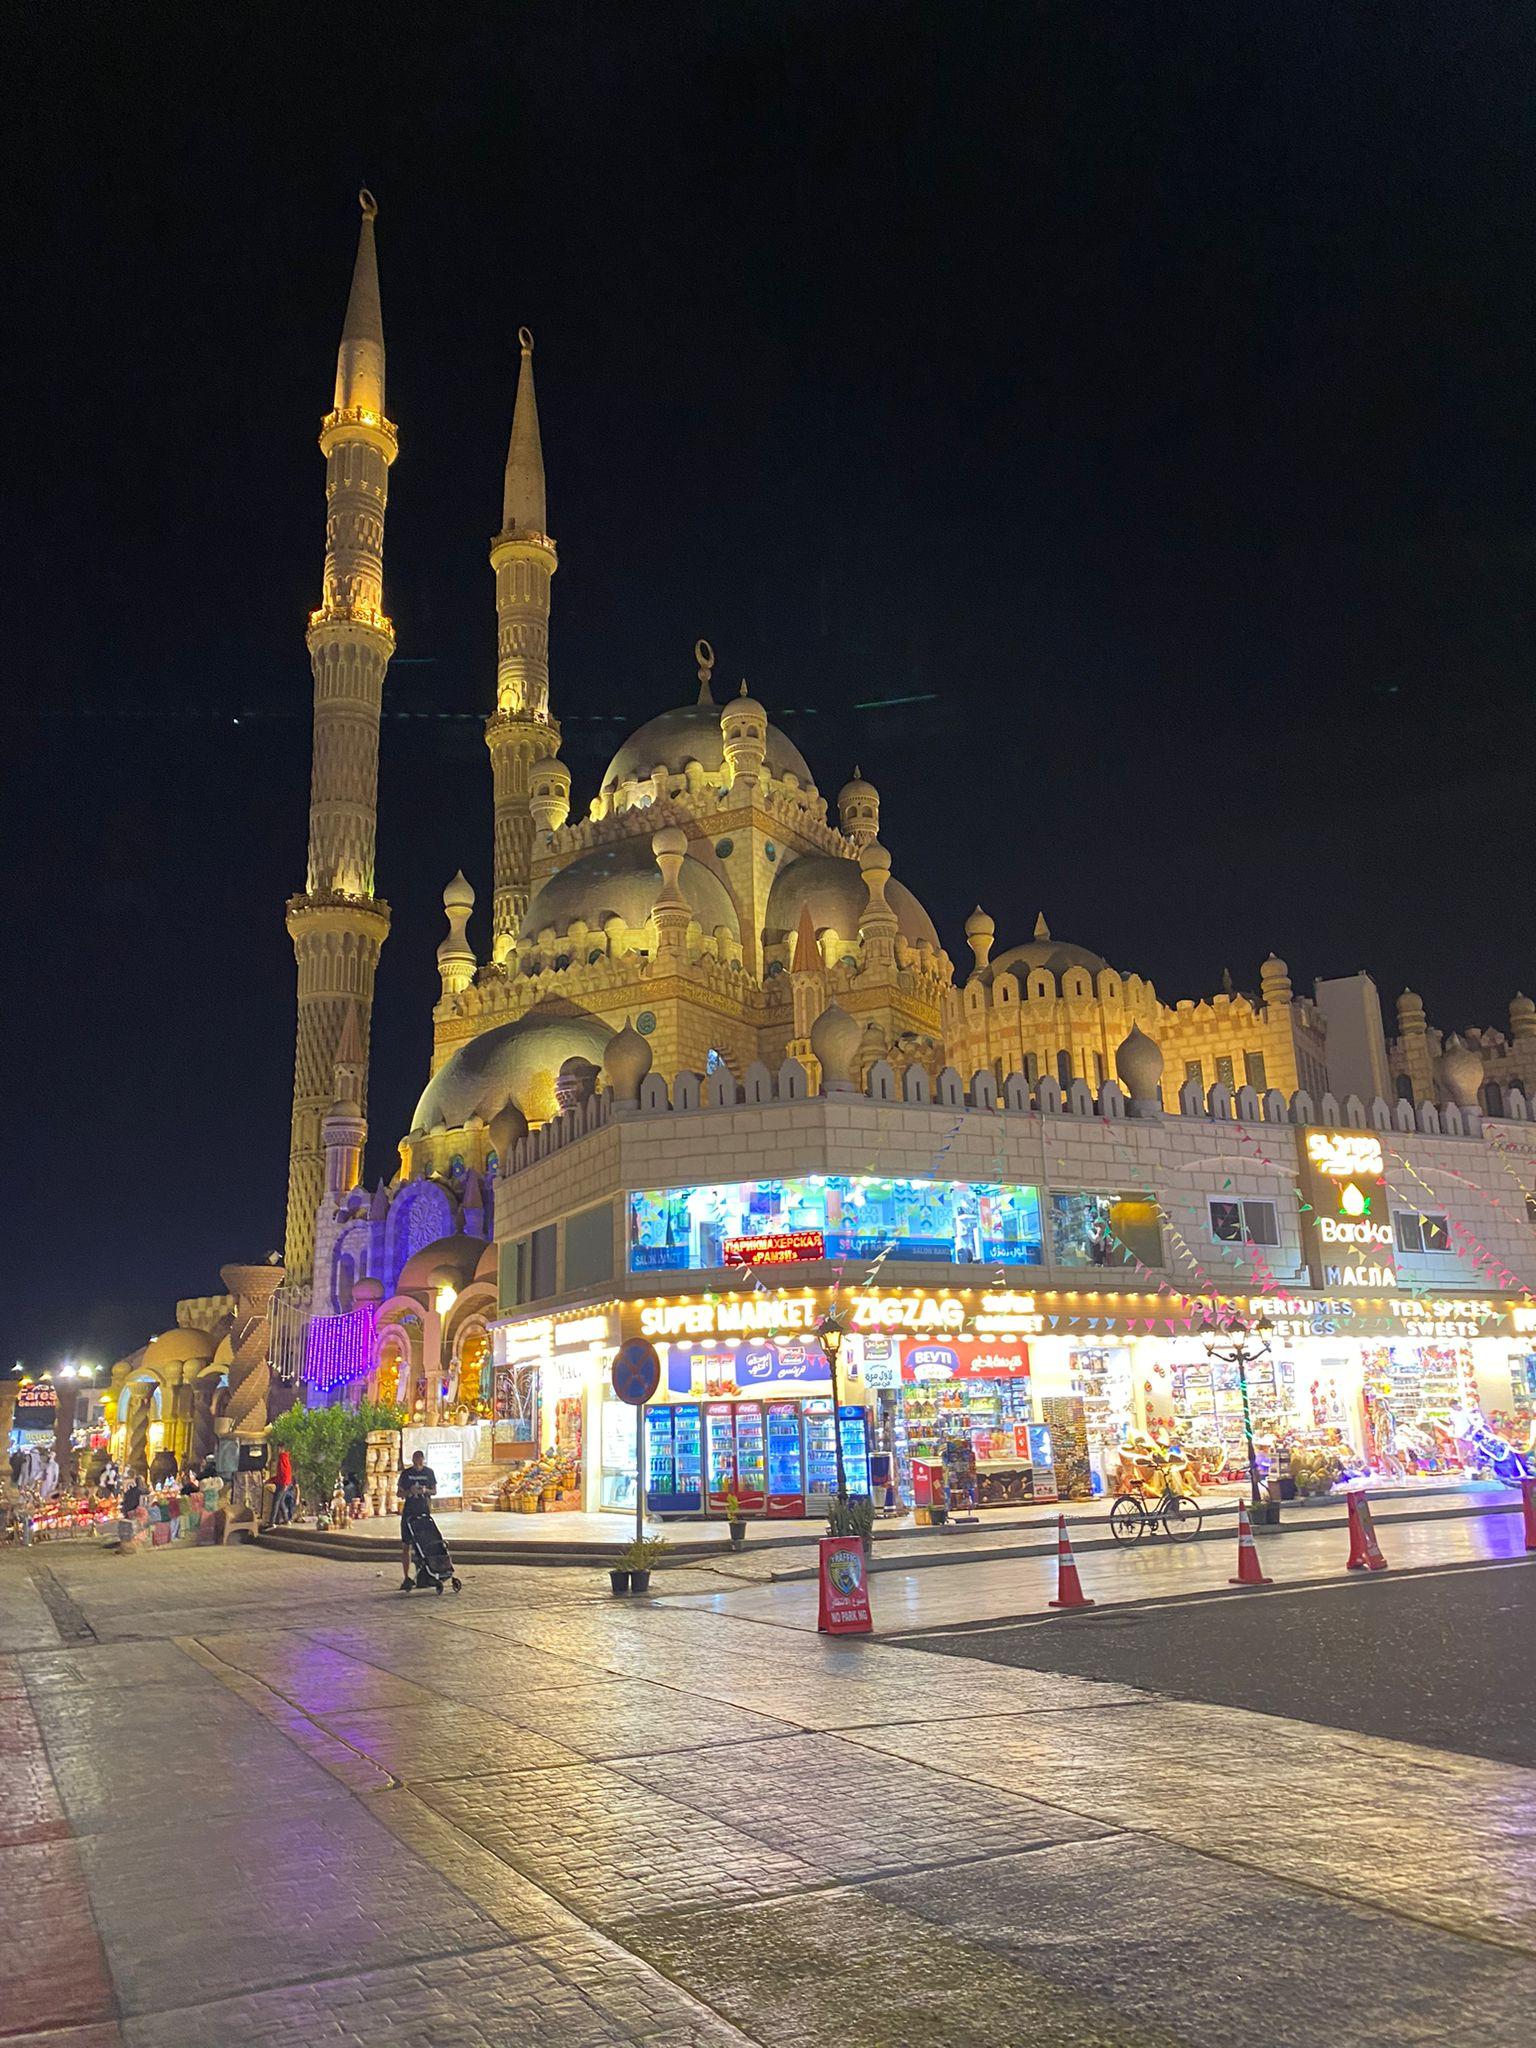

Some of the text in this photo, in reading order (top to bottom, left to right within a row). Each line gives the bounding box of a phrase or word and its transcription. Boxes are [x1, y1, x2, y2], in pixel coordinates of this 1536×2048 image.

[1320, 1217, 1394, 1244] Baraka
[725, 1235, 821, 1253] ПАРИКМАХЕРСКАЯ
[1326, 1265, 1397, 1287] МАСЛА
[641, 1304, 715, 1336] SUPER
[717, 1298, 817, 1331] MARKET
[850, 1297, 966, 1326] ZIGZAG
[1406, 1321, 1480, 1337] SWEETS
[17, 1388, 58, 1400] Fares
